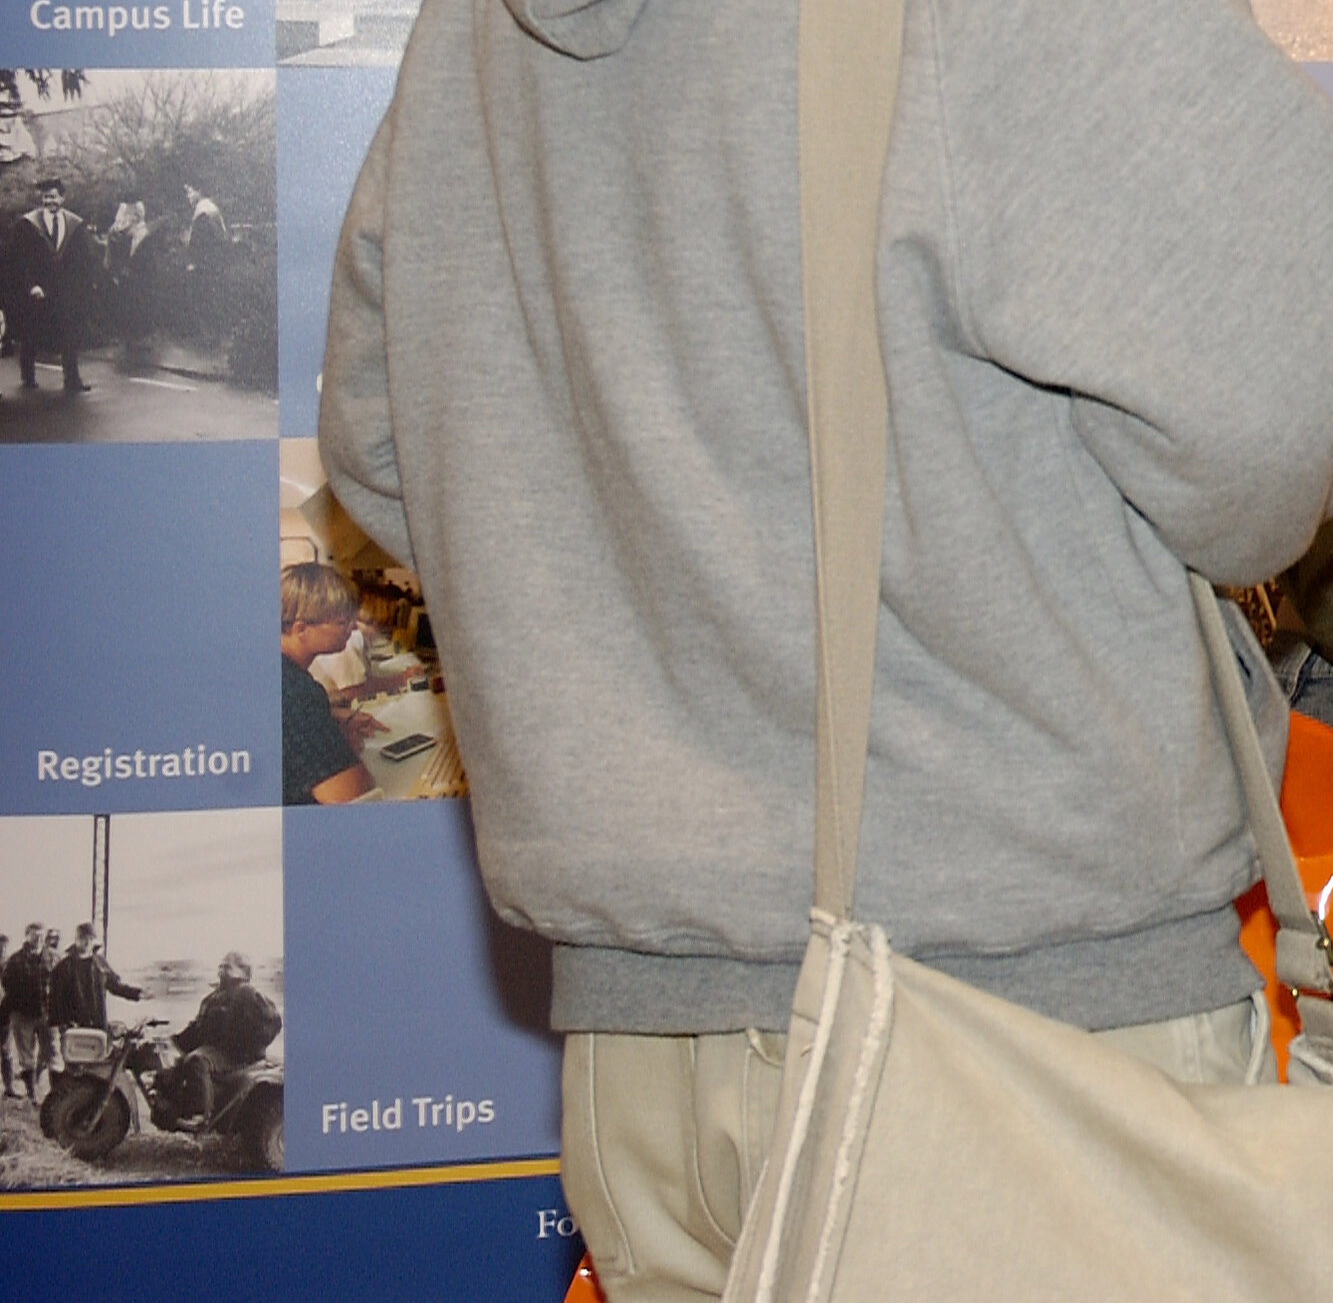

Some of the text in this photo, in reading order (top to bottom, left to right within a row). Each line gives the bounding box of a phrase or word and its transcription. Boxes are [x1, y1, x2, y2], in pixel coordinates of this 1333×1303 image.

[37, 744, 251, 787] Registration
[321, 1094, 497, 1134] Field Trips
[535, 1208, 579, 1240] Fo
